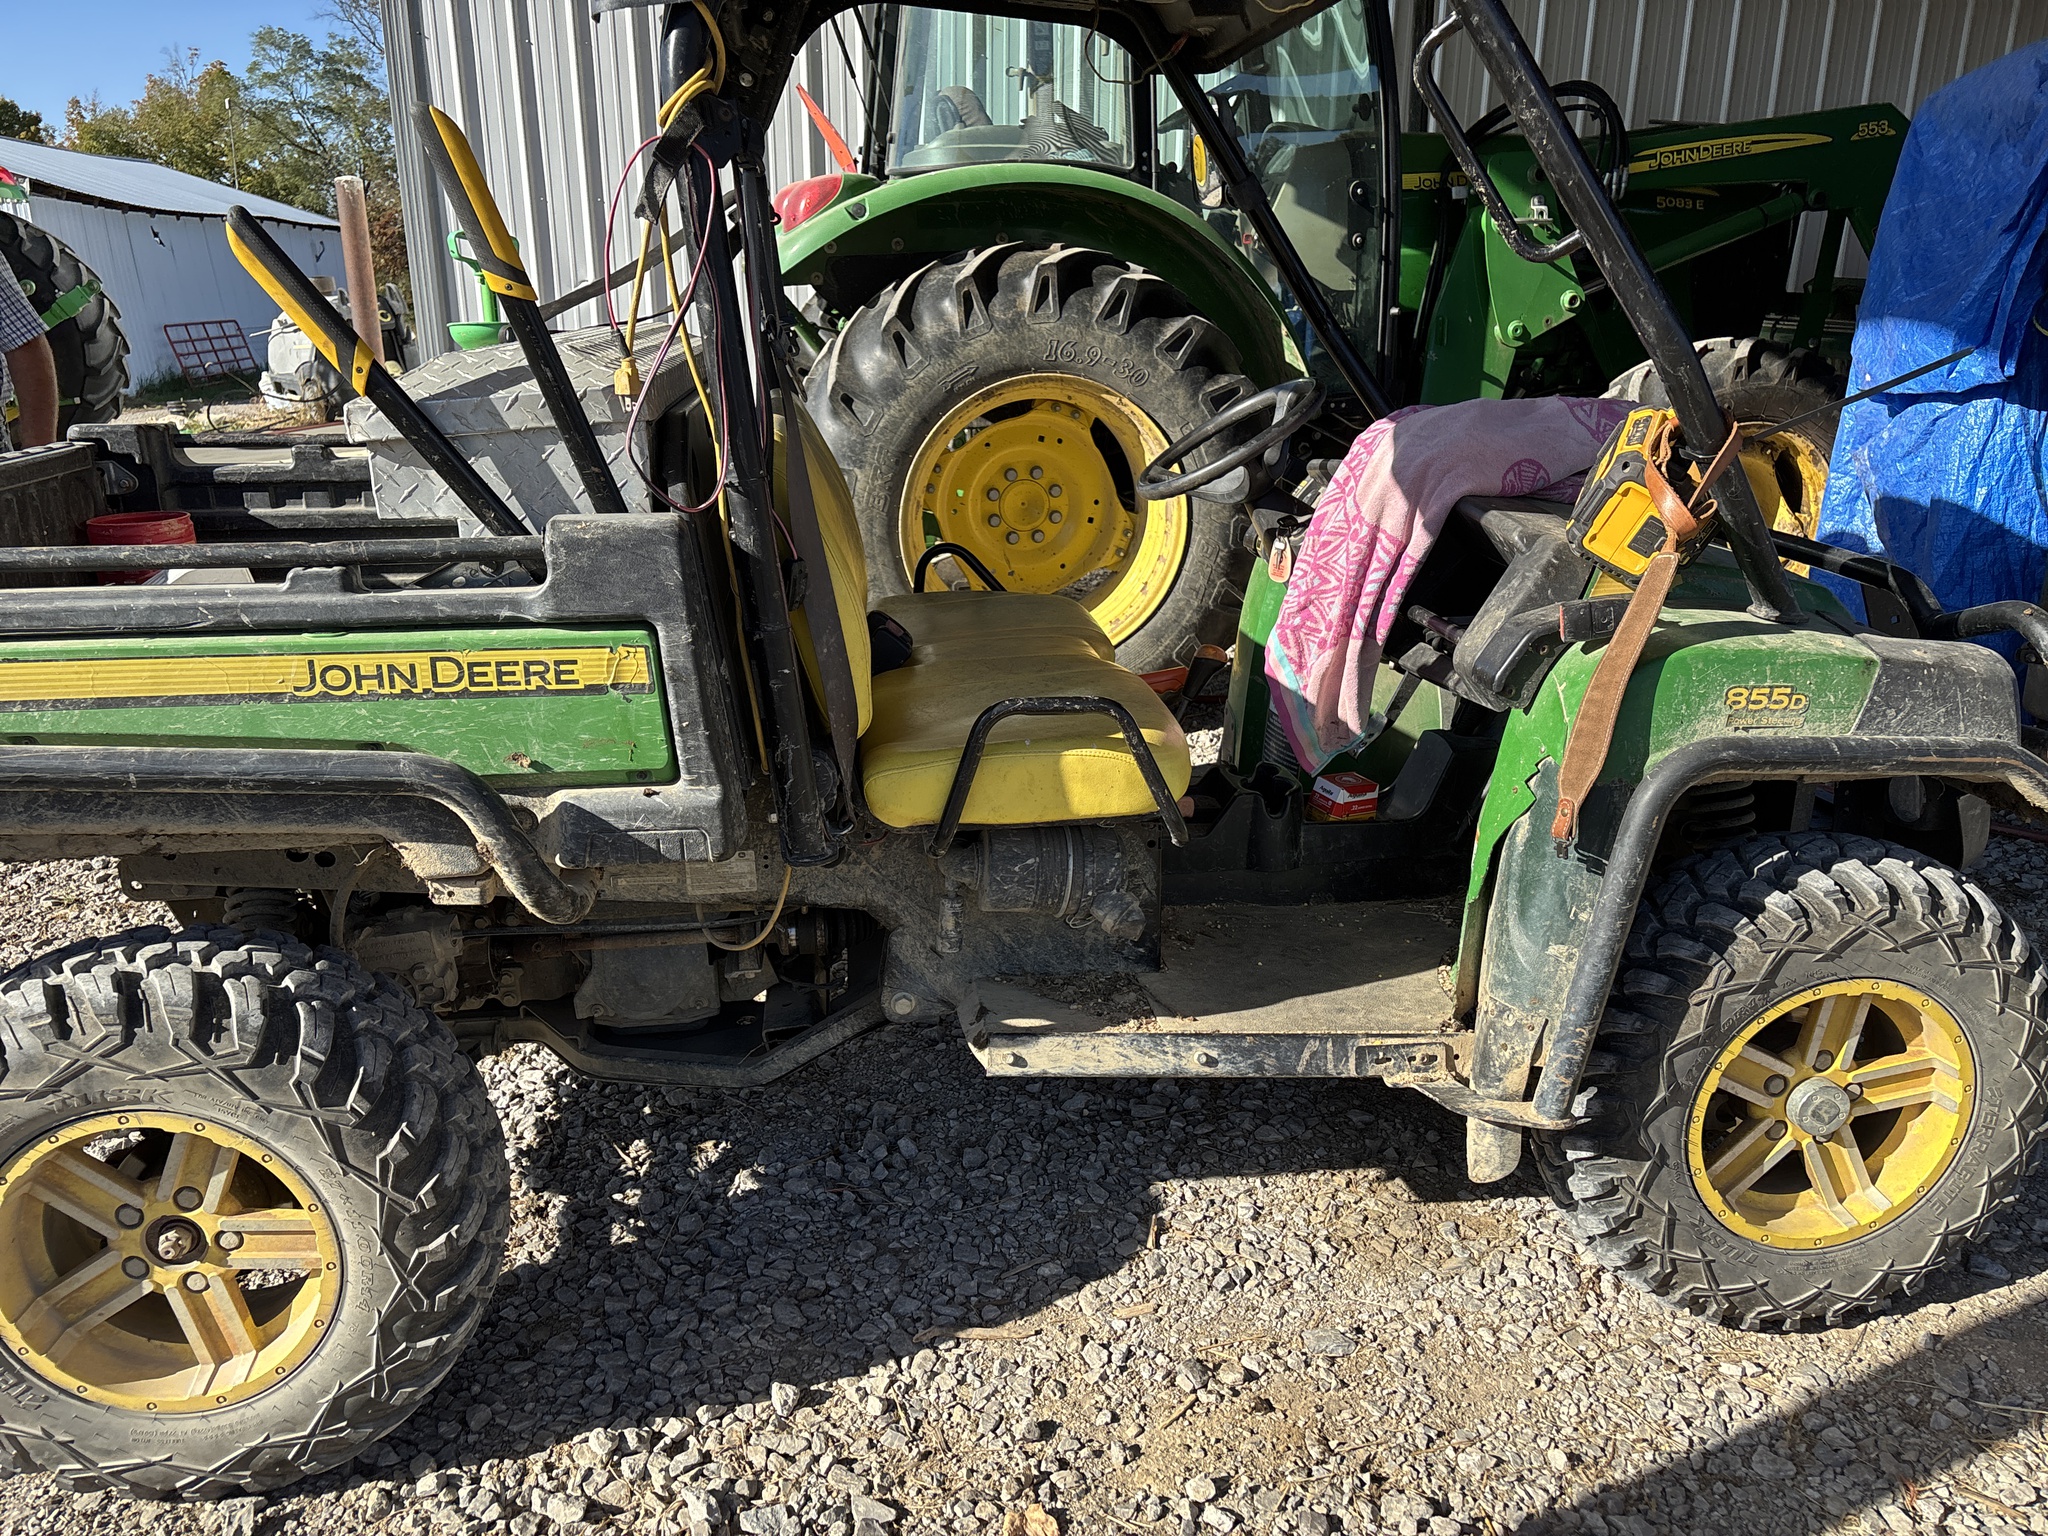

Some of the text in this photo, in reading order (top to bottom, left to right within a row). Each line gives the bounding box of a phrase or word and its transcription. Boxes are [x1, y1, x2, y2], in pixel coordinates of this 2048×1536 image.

[1858, 120, 1889, 137] 553
[1649, 141, 1752, 170] JOHN DEERE
[1656, 196, 1704, 210] 5083 E
[1043, 338, 1150, 388] 16.9-30
[293, 656, 580, 697] JOHN DEERE
[1727, 687, 1808, 711] 855D
[1728, 716, 1803, 727] Power Steering
[1927, 1097, 2001, 1221] TERRABITE
